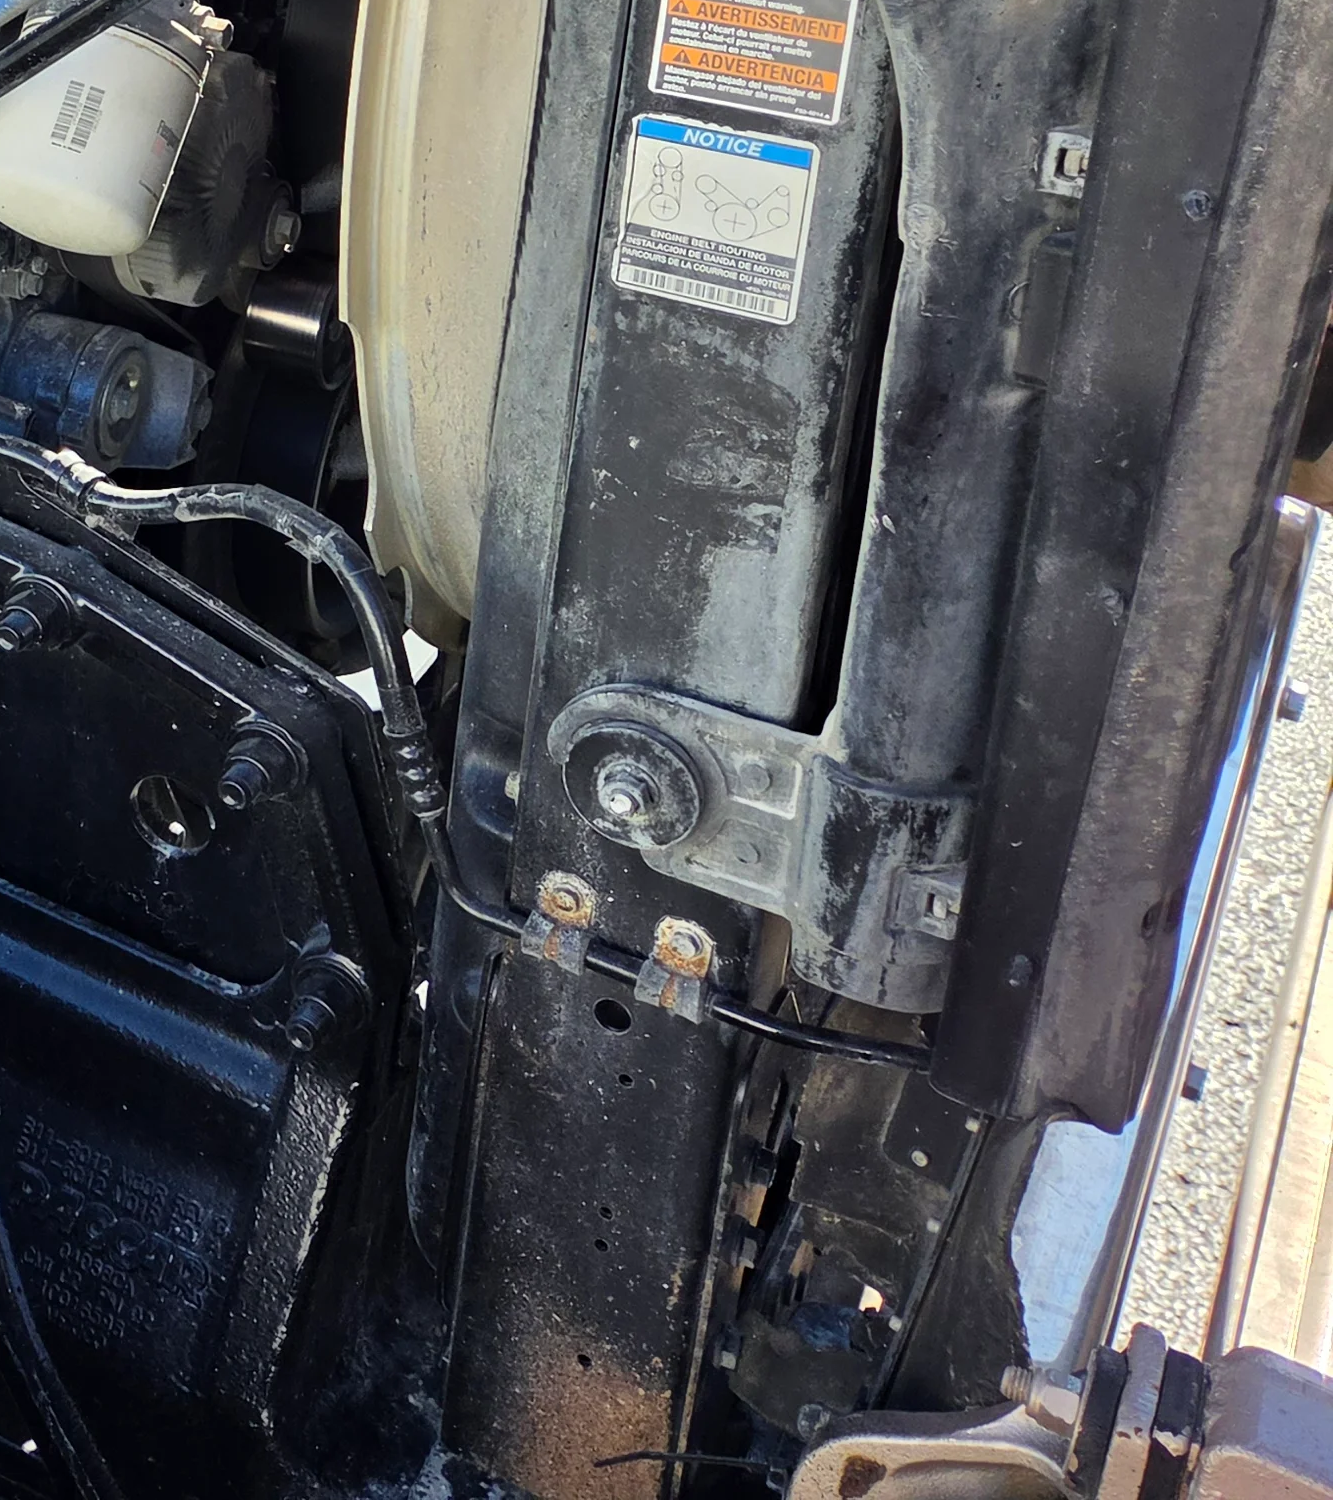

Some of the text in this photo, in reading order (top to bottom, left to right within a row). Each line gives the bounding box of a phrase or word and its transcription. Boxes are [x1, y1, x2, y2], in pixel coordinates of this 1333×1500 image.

[697, 2, 843, 40] AVERTISSEMENT
[768, 1, 805, 14] warning.
[669, 36, 727, 52] soudainement
[729, 46, 739, 54] en
[671, 18, 699, 30] Restez
[737, 28, 748, 37] du
[750, 30, 794, 46] ventilateur
[796, 38, 808, 48] du
[736, 37, 770, 51] pourrait
[771, 44, 782, 52] se
[784, 46, 812, 58] mettre
[698, 52, 824, 88] ADVERTENCIA
[691, 79, 716, 91] puede
[718, 84, 753, 97] arrancar
[755, 90, 768, 99] sin
[770, 92, 796, 105] previo
[716, 73, 746, 87] alejado
[748, 78, 761, 88] del
[764, 81, 806, 97] ventilador
[807, 90, 821, 100] del
[684, 129, 764, 157] NOTICE
[626, 236, 790, 279] INSTALACION DE BANDA DE MOTOR
[651, 229, 767, 262] ENGINE BELT ROUTING
[621, 246, 666, 264] PARCOURS
[668, 257, 679, 267] DE
[681, 259, 692, 269] LA
[694, 262, 738, 281] COURROIE
[739, 272, 751, 283] DU
[753, 275, 791, 291] MOTEUR
